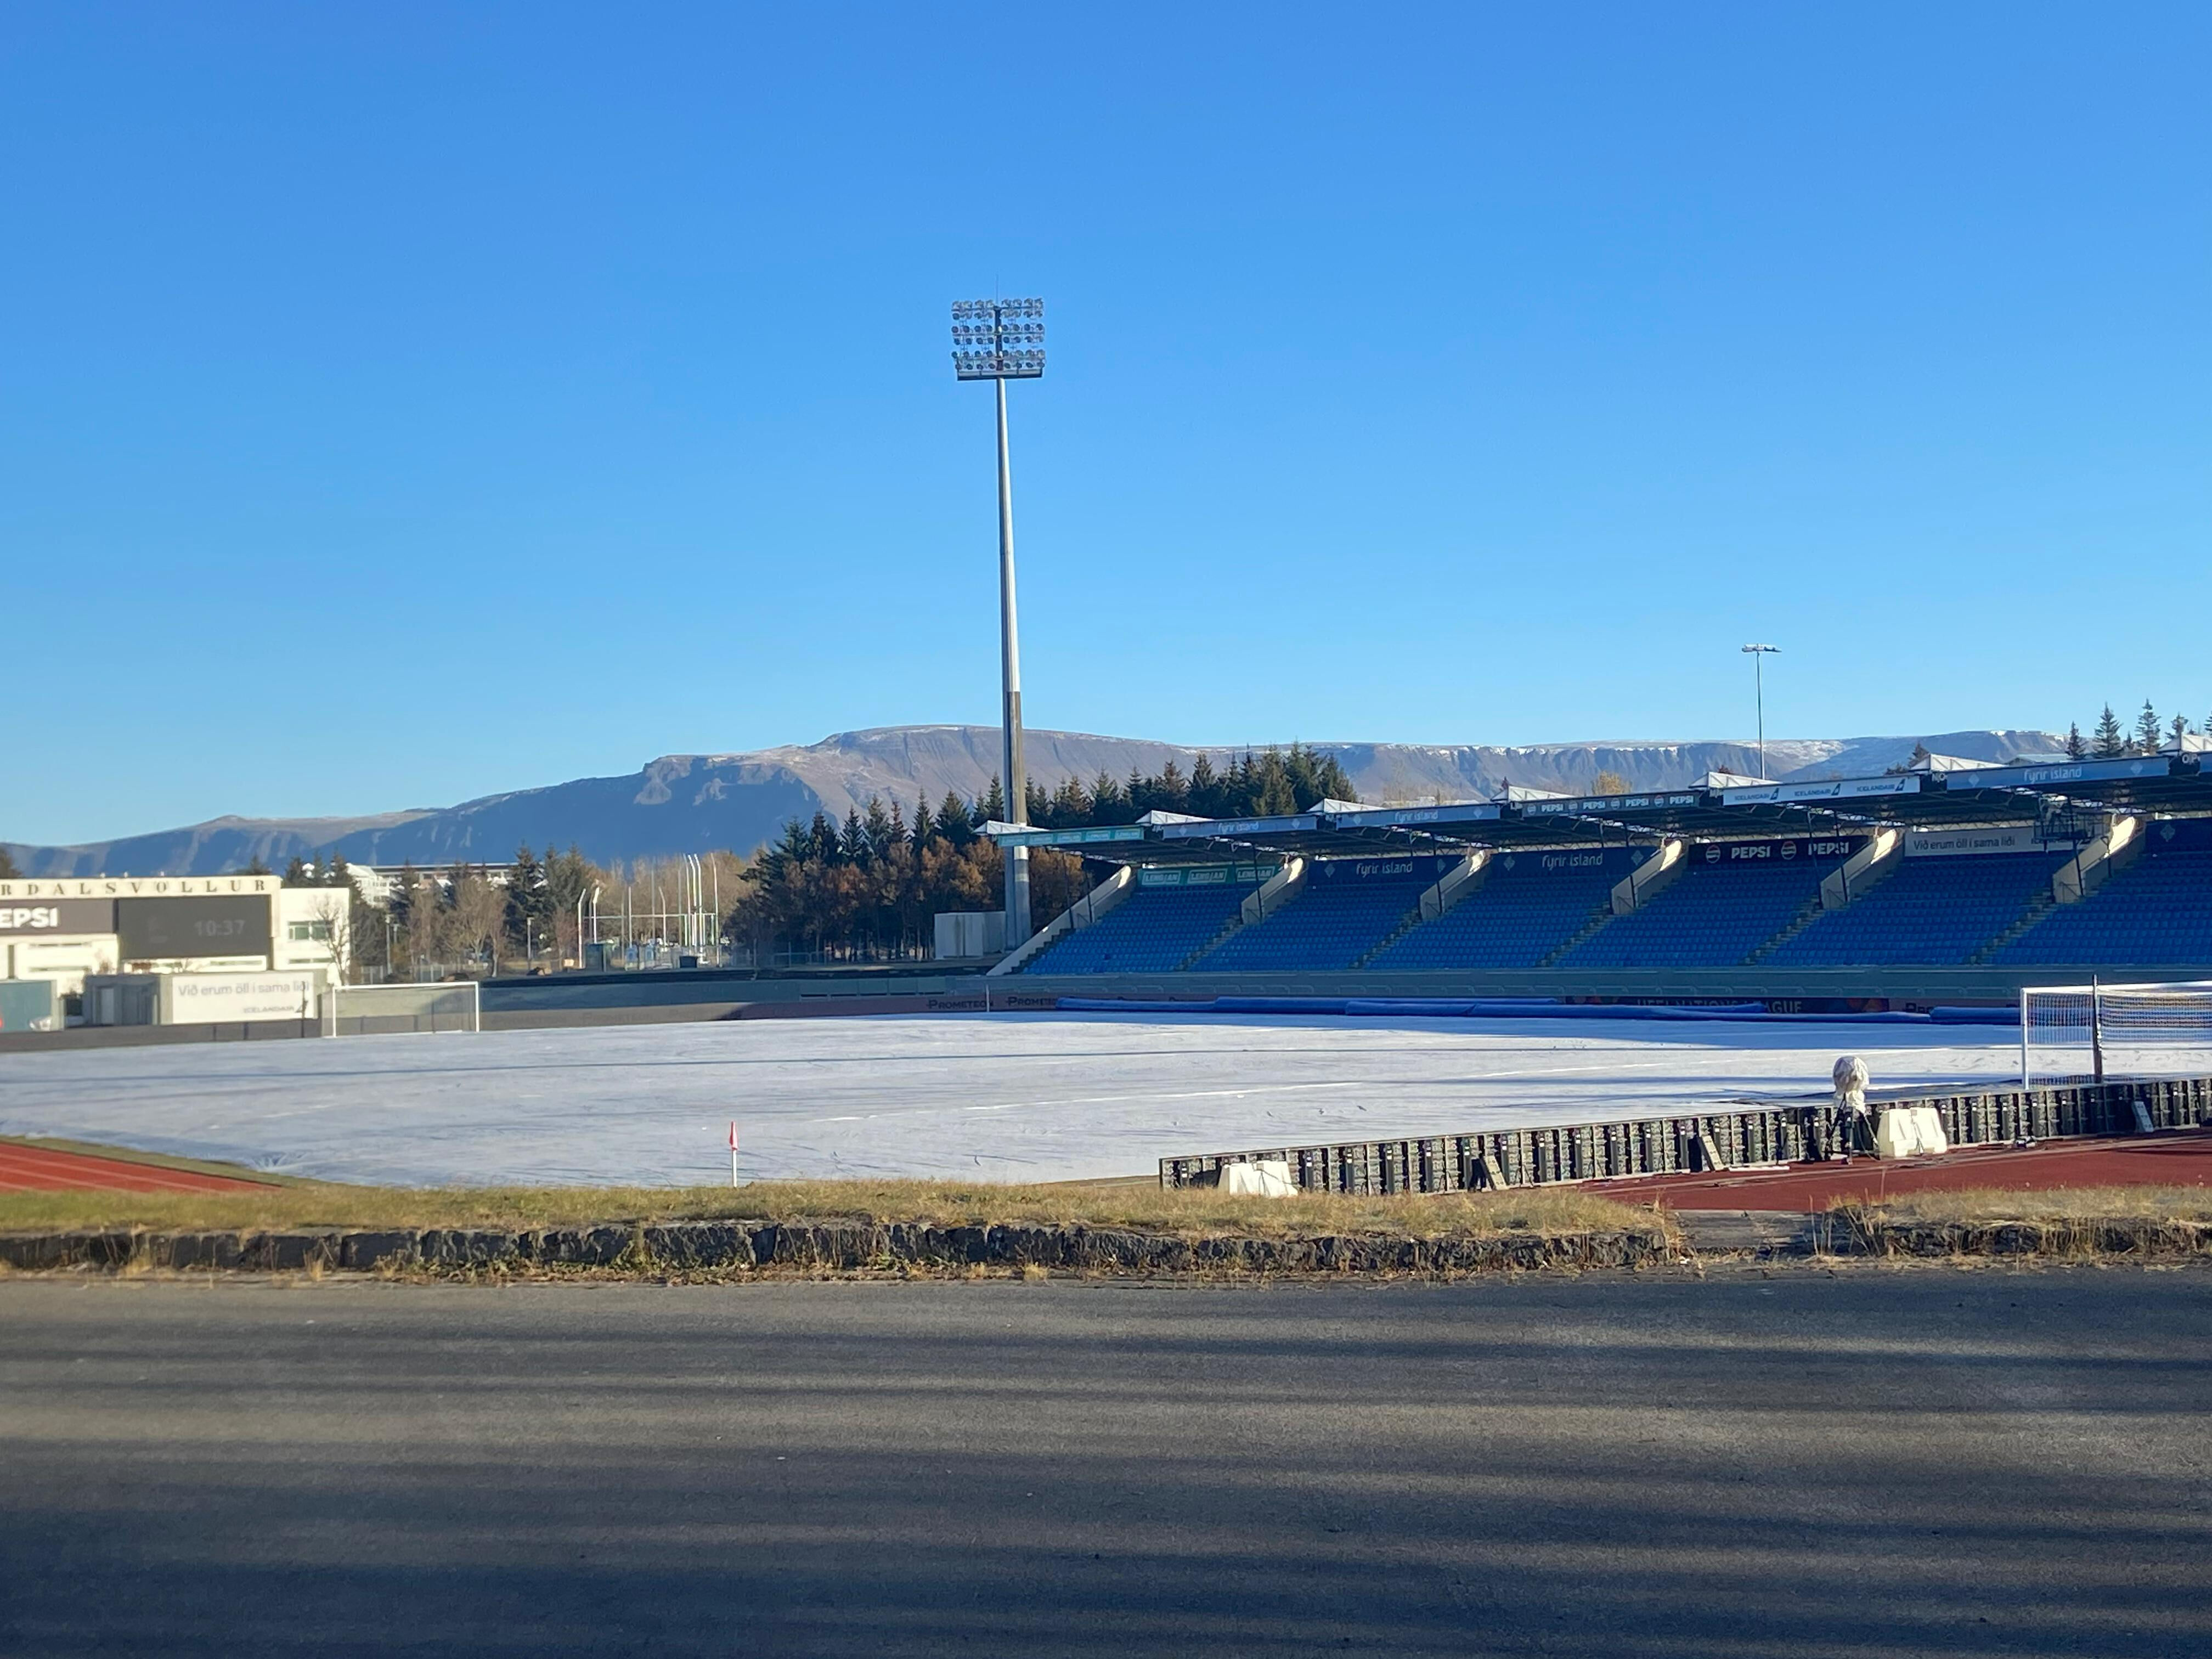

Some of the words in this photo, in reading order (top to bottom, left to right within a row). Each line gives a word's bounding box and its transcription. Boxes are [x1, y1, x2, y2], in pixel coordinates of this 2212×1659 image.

[1583, 801, 1605, 810] PEPSI
[1626, 798, 1649, 807] PEPSI
[1669, 795, 1694, 804] PEPSI
[1541, 804, 1564, 812] PEPSI
[1808, 842, 1849, 856] PEPSI
[1914, 840, 1928, 850] Við
[1930, 840, 1954, 849] erum
[1956, 838, 1967, 848] öll
[1974, 839, 1999, 848] sama
[1731, 845, 1771, 859] PEPSI
[1542, 854, 1566, 871] fyrir
[1356, 862, 1379, 878] fyrir
[194, 919, 246, 936] 10:37
[178, 984, 198, 996] Við
[201, 986, 233, 995] erum
[258, 984, 290, 993] sama
